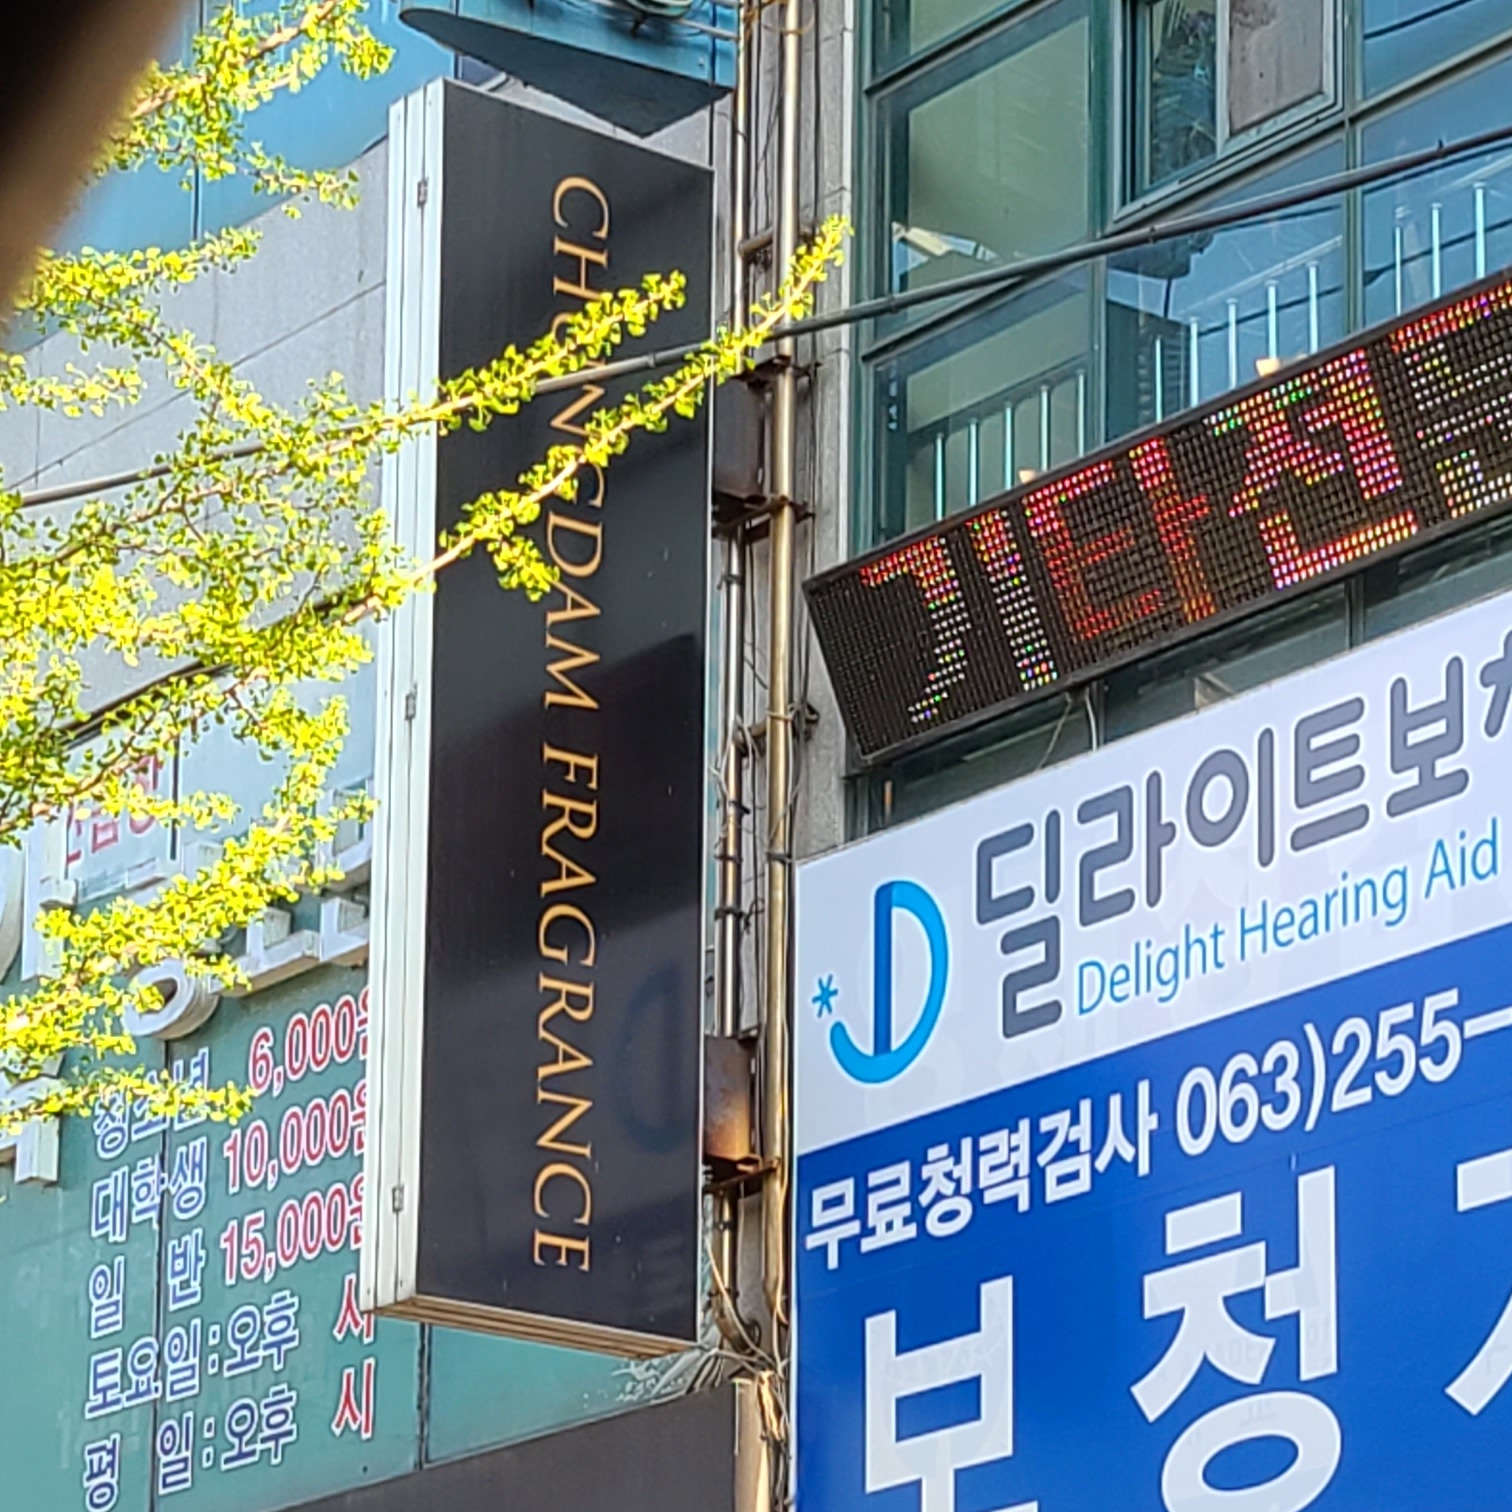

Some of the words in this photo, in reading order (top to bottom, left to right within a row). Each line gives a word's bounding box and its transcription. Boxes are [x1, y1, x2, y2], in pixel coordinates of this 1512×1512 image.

[532, 741, 599, 1272] FRAGRANCE
[1077, 922, 1225, 1016] Delight
[1240, 866, 1408, 961] Hearing
[1424, 817, 1499, 899] Aid
[805, 1078, 1158, 1270] 무료청력검사
[331, 1357, 376, 1440] 시
